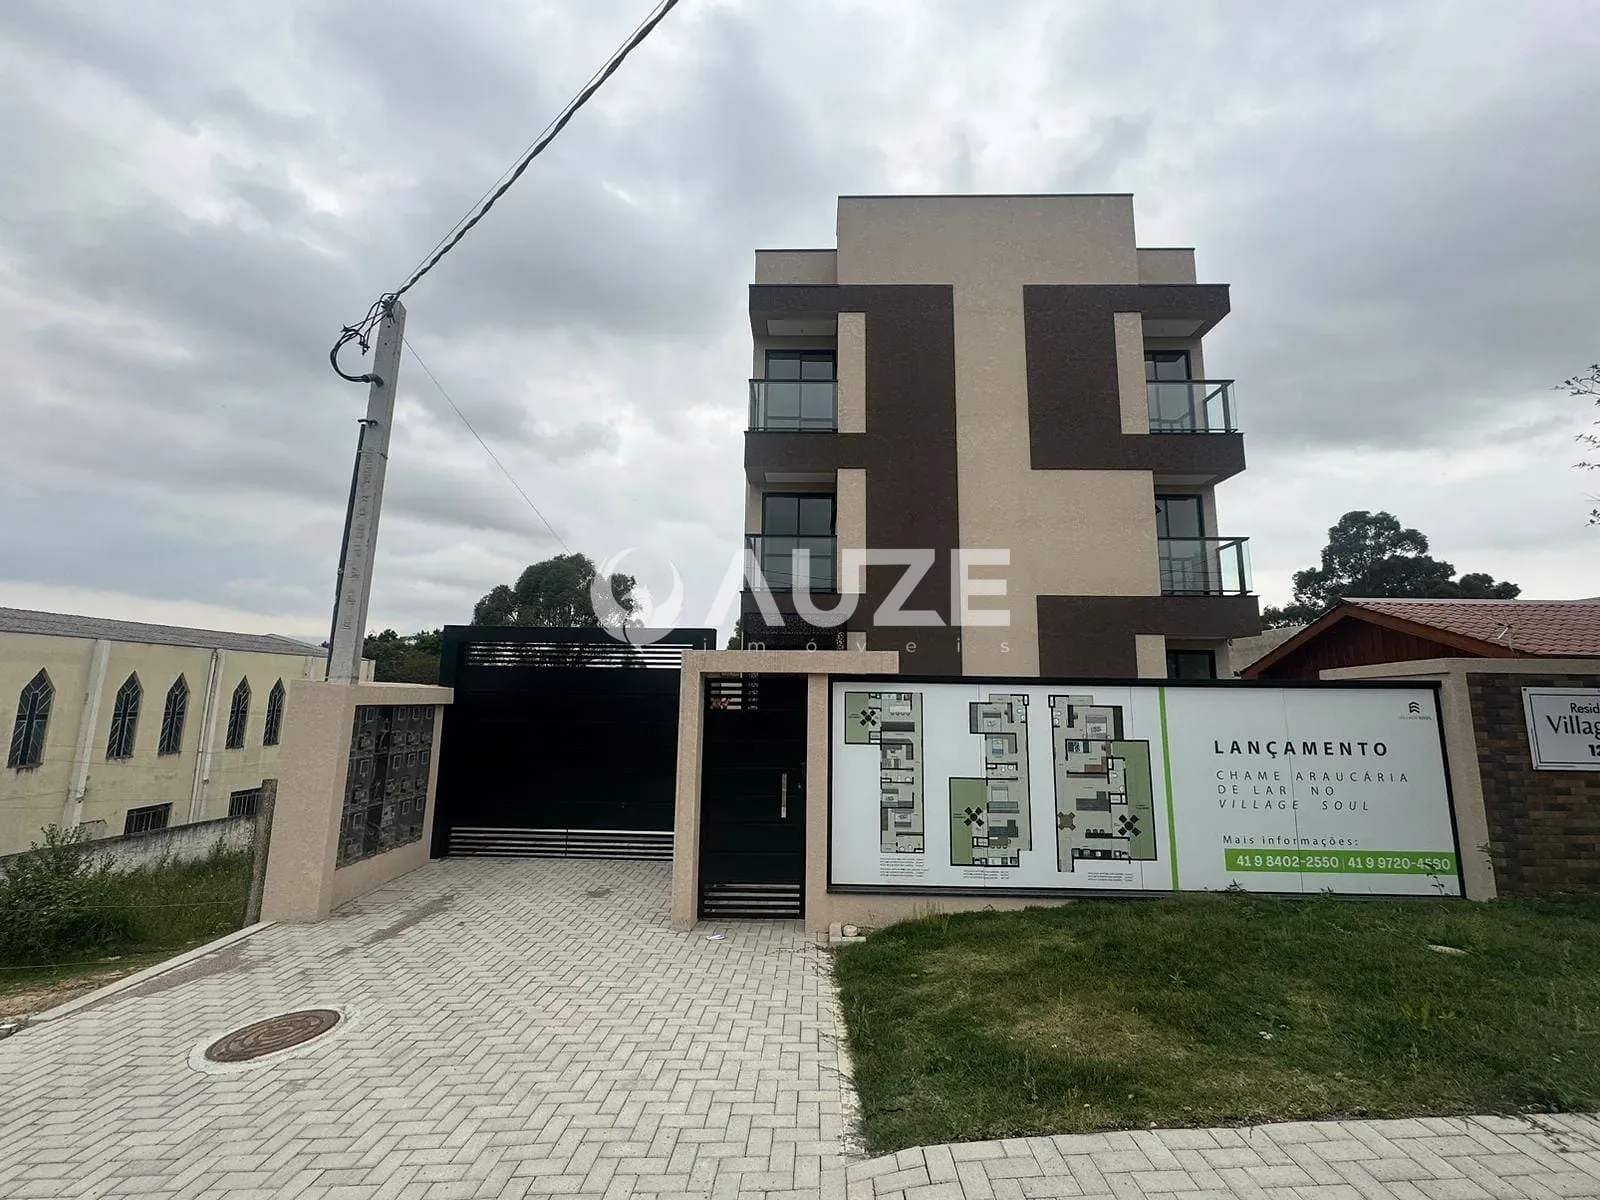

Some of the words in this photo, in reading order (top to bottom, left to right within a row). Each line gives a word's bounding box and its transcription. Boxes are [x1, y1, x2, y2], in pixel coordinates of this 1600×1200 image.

[1570, 702, 1600, 714] Resid
[1546, 715, 1600, 741] Villag
[1214, 740, 1387, 759] LANÇAMENTO
[1216, 770, 1281, 781] CHAME
[1295, 770, 1408, 783] ARAUCÁRIA
[1218, 785, 1239, 795] DE
[1253, 785, 1287, 796] LAR
[1311, 786, 1334, 796] NO
[1219, 799, 1299, 810] VILLAGE
[1322, 800, 1369, 811] SOUL
[1223, 835, 1254, 845] Mais
[1262, 835, 1359, 848] informações:
[1236, 855, 1251, 867] 41
[1254, 855, 1262, 867] 9
[1266, 855, 1339, 868] 8402-2550
[1348, 857, 1362, 868] 41
[1366, 857, 1374, 869] 9
